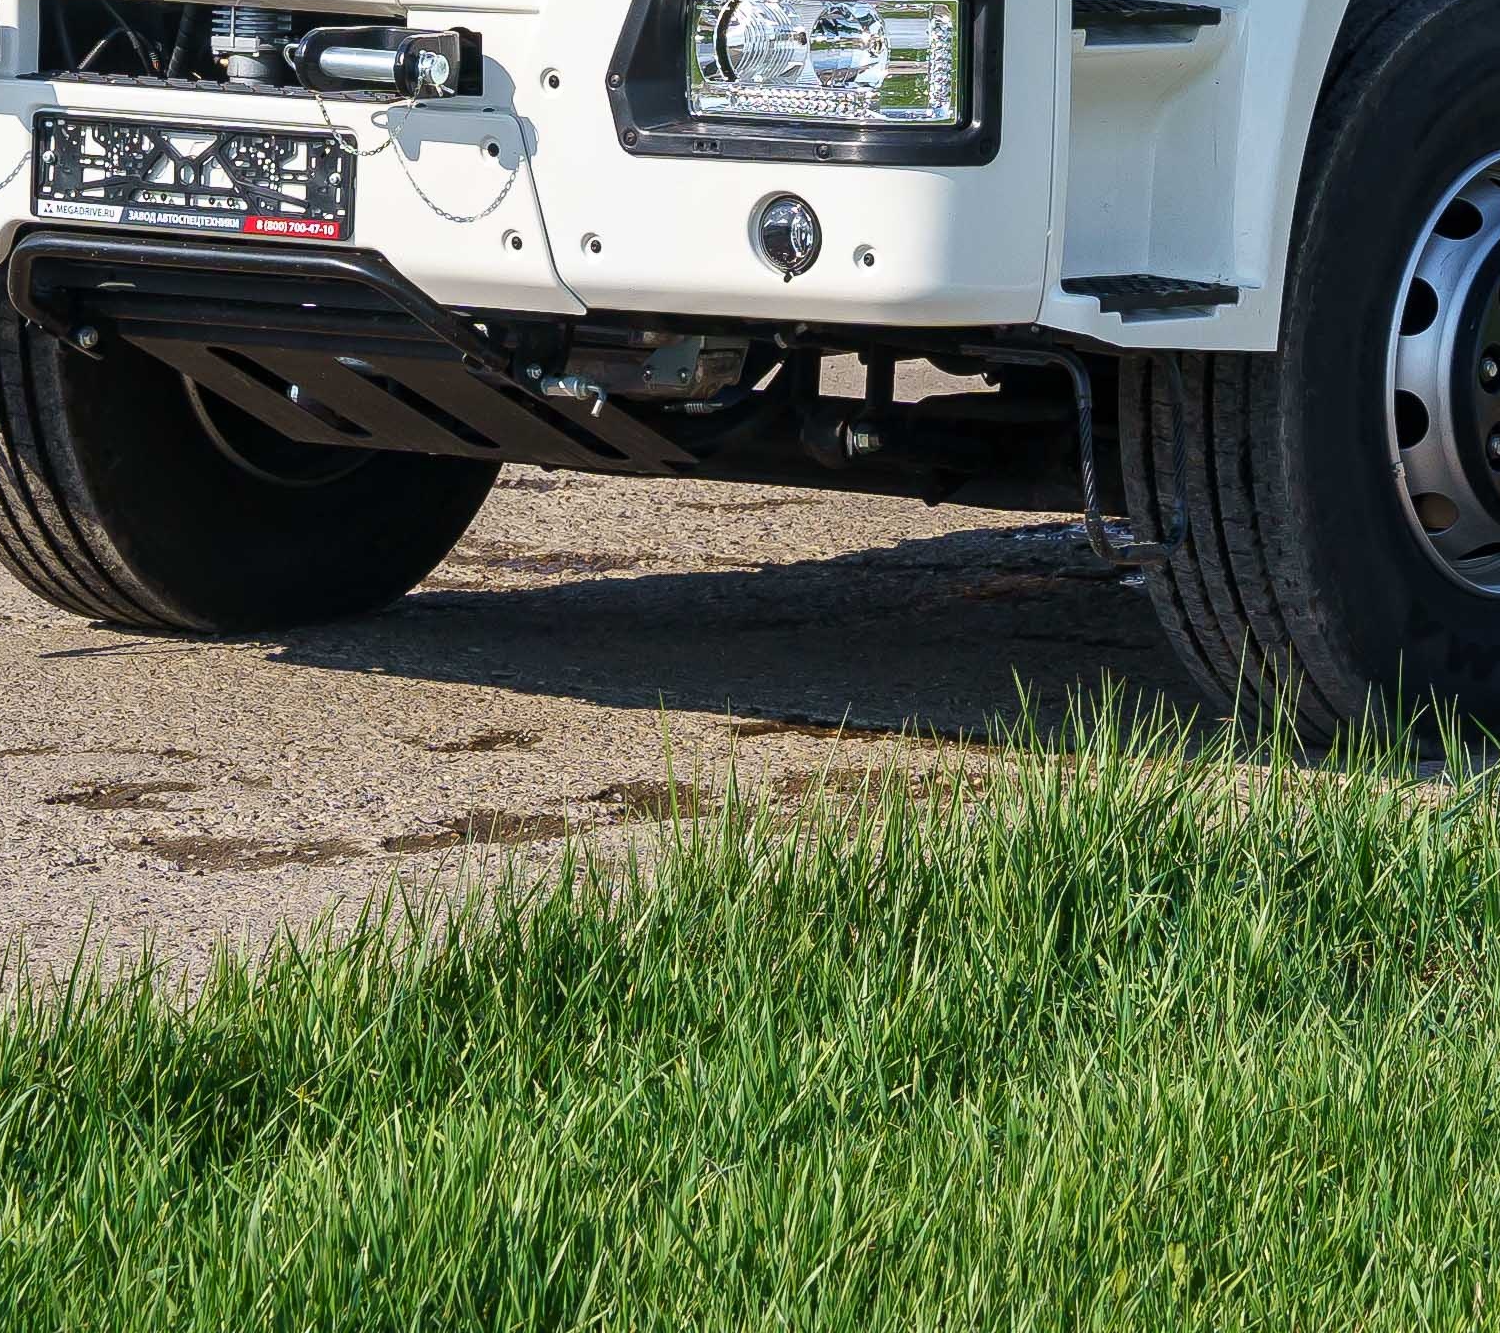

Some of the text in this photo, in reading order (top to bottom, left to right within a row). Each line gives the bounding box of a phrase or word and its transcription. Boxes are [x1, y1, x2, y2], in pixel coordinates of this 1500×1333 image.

[56, 204, 116, 219] MEGADRIVE.RU
[127, 210, 156, 225] ЗАВОД
[156, 211, 240, 229] АВТОСПЕЦТЕХНИКИ
[263, 219, 287, 233] (800)
[288, 221, 334, 236] 700-47-10
